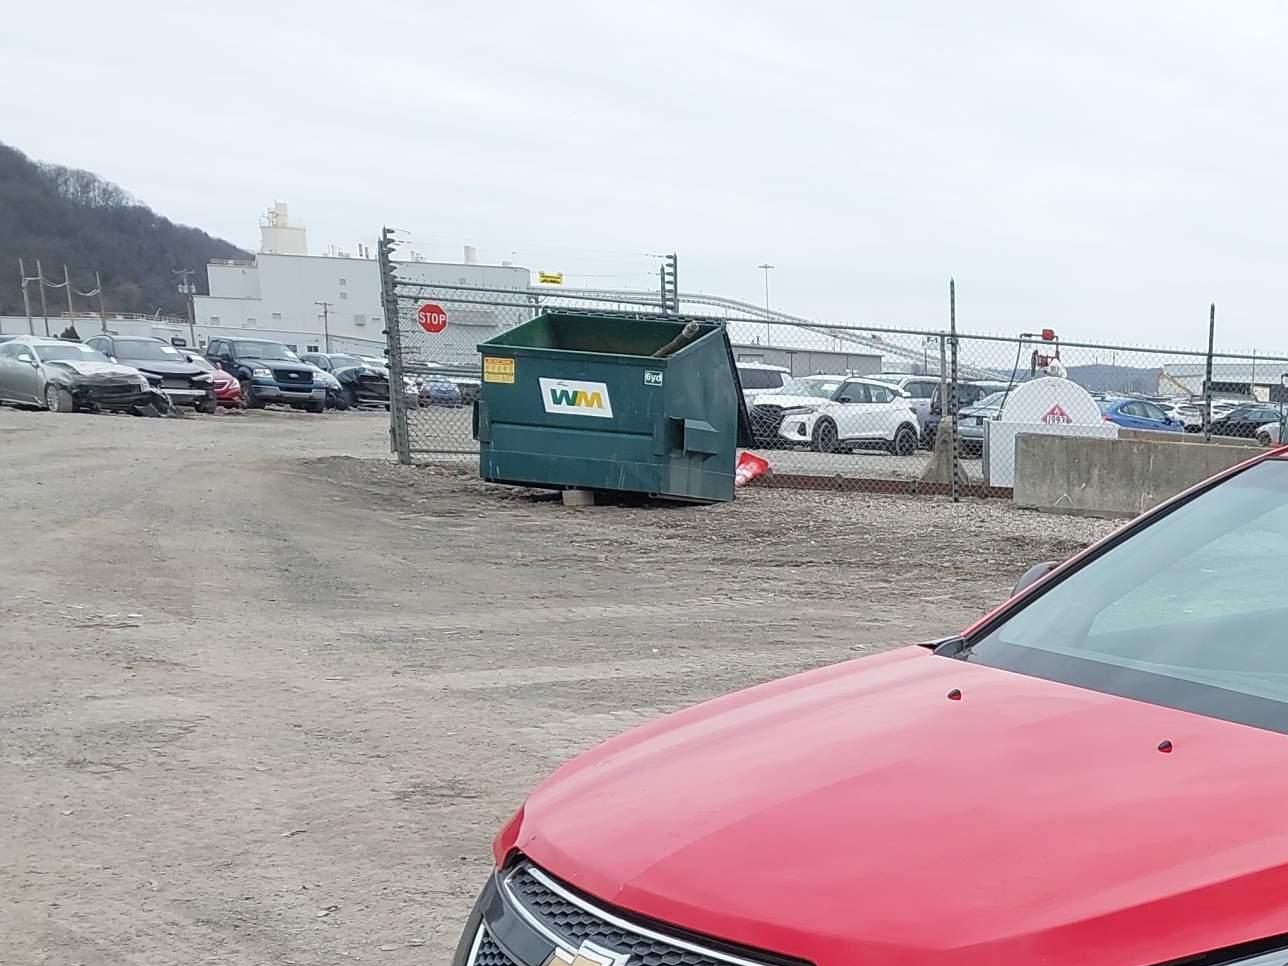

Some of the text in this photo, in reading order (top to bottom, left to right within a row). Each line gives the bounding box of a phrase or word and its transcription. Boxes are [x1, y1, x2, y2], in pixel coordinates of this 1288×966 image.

[419, 311, 446, 325] STOP
[645, 372, 663, 383] 6yd
[550, 388, 604, 409] WM
